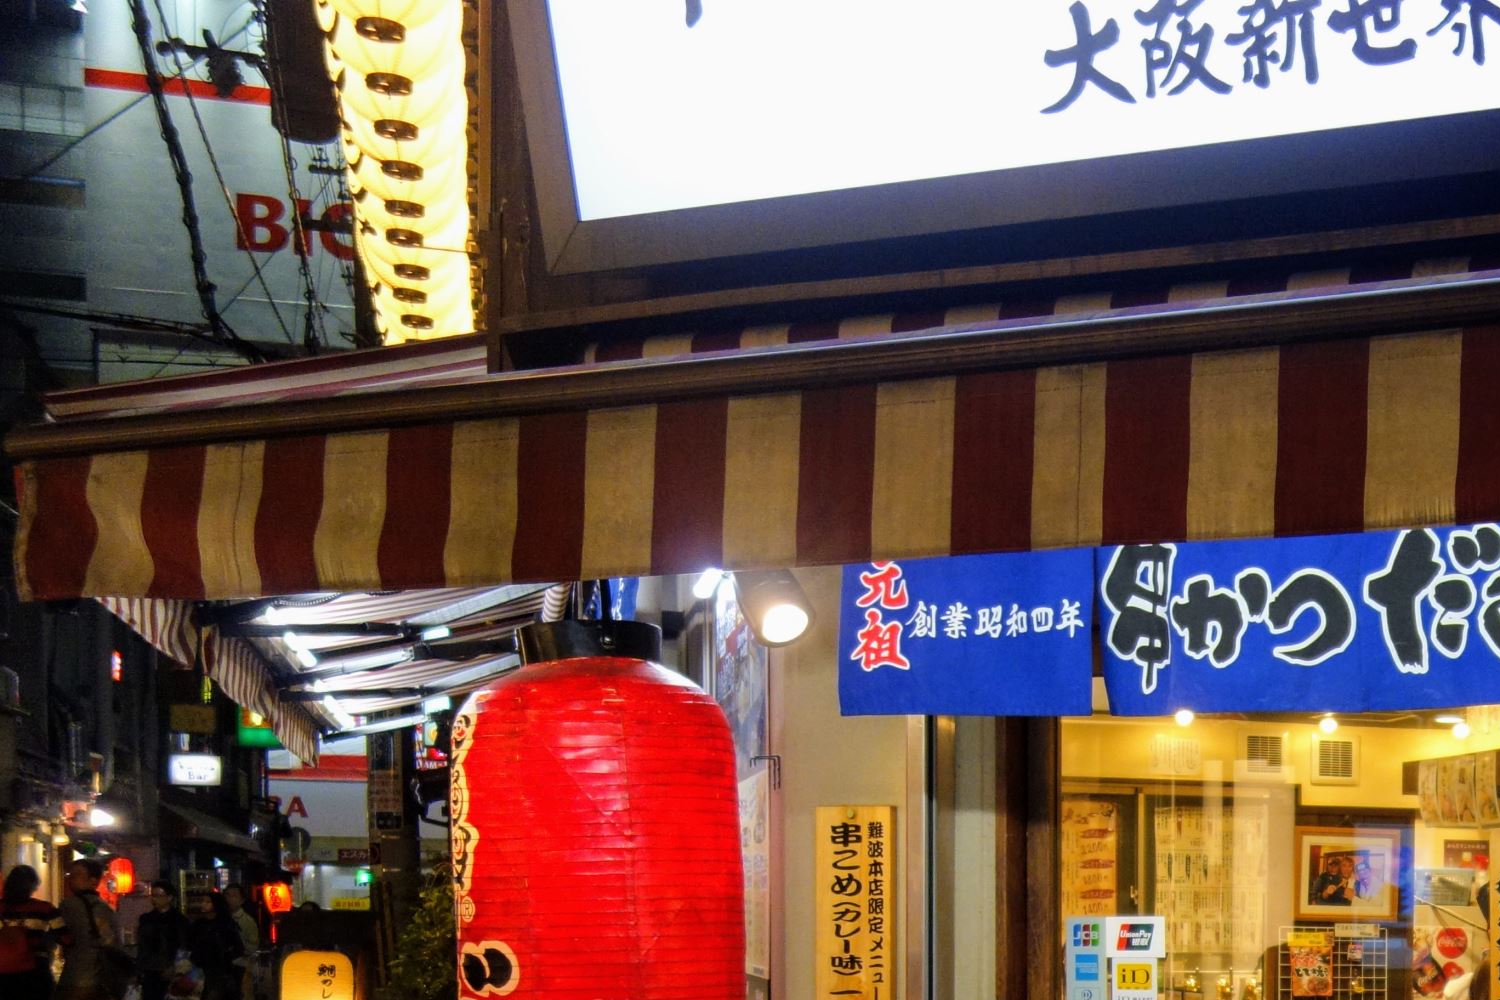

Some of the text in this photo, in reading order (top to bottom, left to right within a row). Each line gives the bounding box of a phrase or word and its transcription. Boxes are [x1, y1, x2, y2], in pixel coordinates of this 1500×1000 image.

[906, 598, 1085, 639] 創業昭和四年
[1121, 968, 1150, 984] iD
